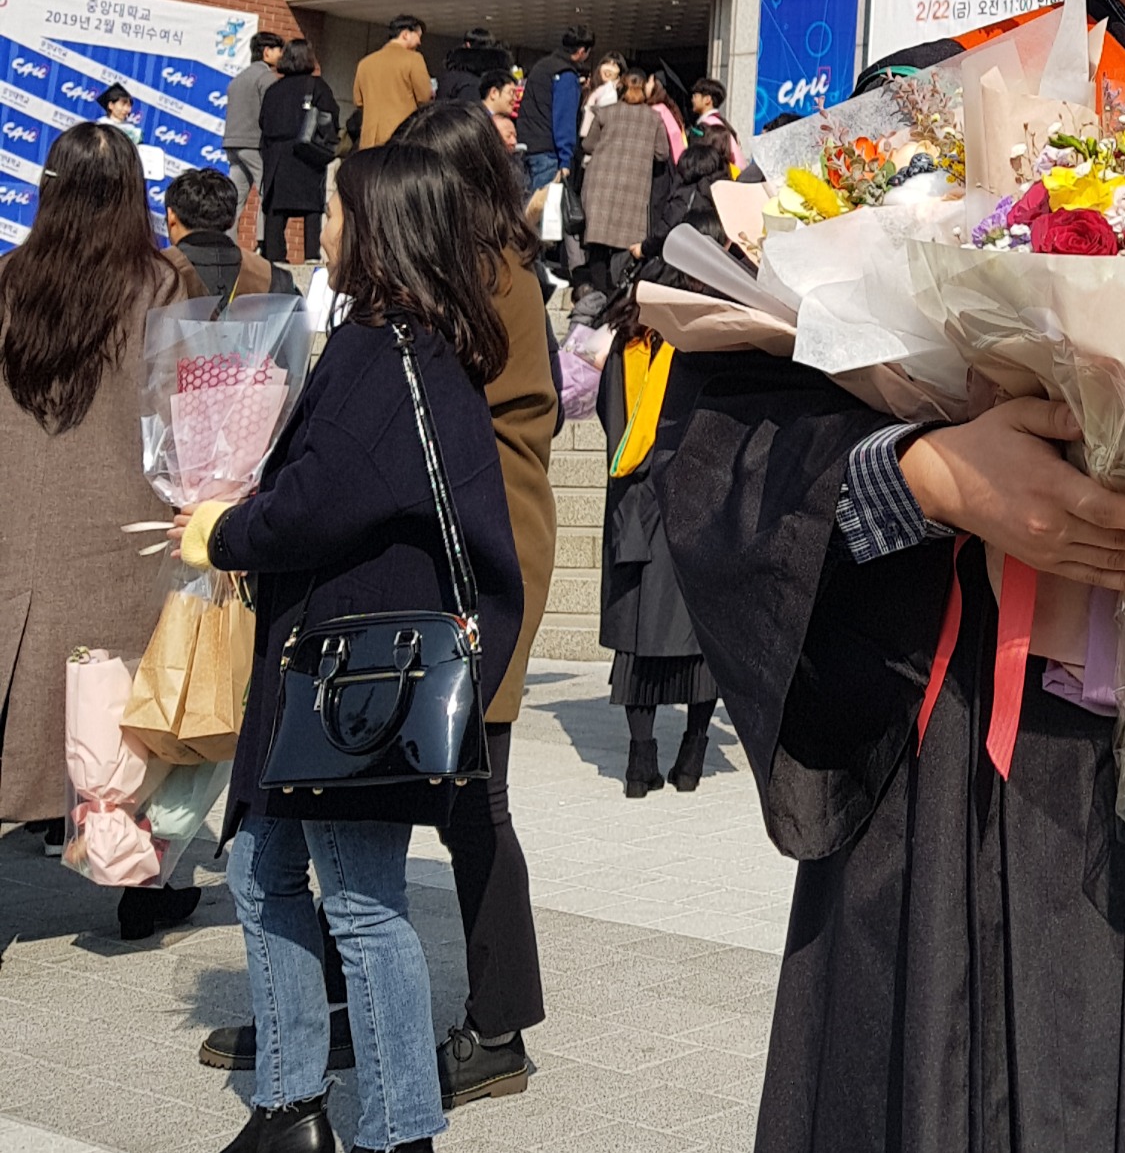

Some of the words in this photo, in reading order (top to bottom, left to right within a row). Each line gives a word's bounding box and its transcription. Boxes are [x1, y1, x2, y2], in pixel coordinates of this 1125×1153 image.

[916, 0, 950, 21] 2/22
[977, 0, 999, 17] 오전
[45, 10, 91, 31] 2019년
[94, 18, 115, 34] 2월
[121, 22, 183, 45] 학위수여식
